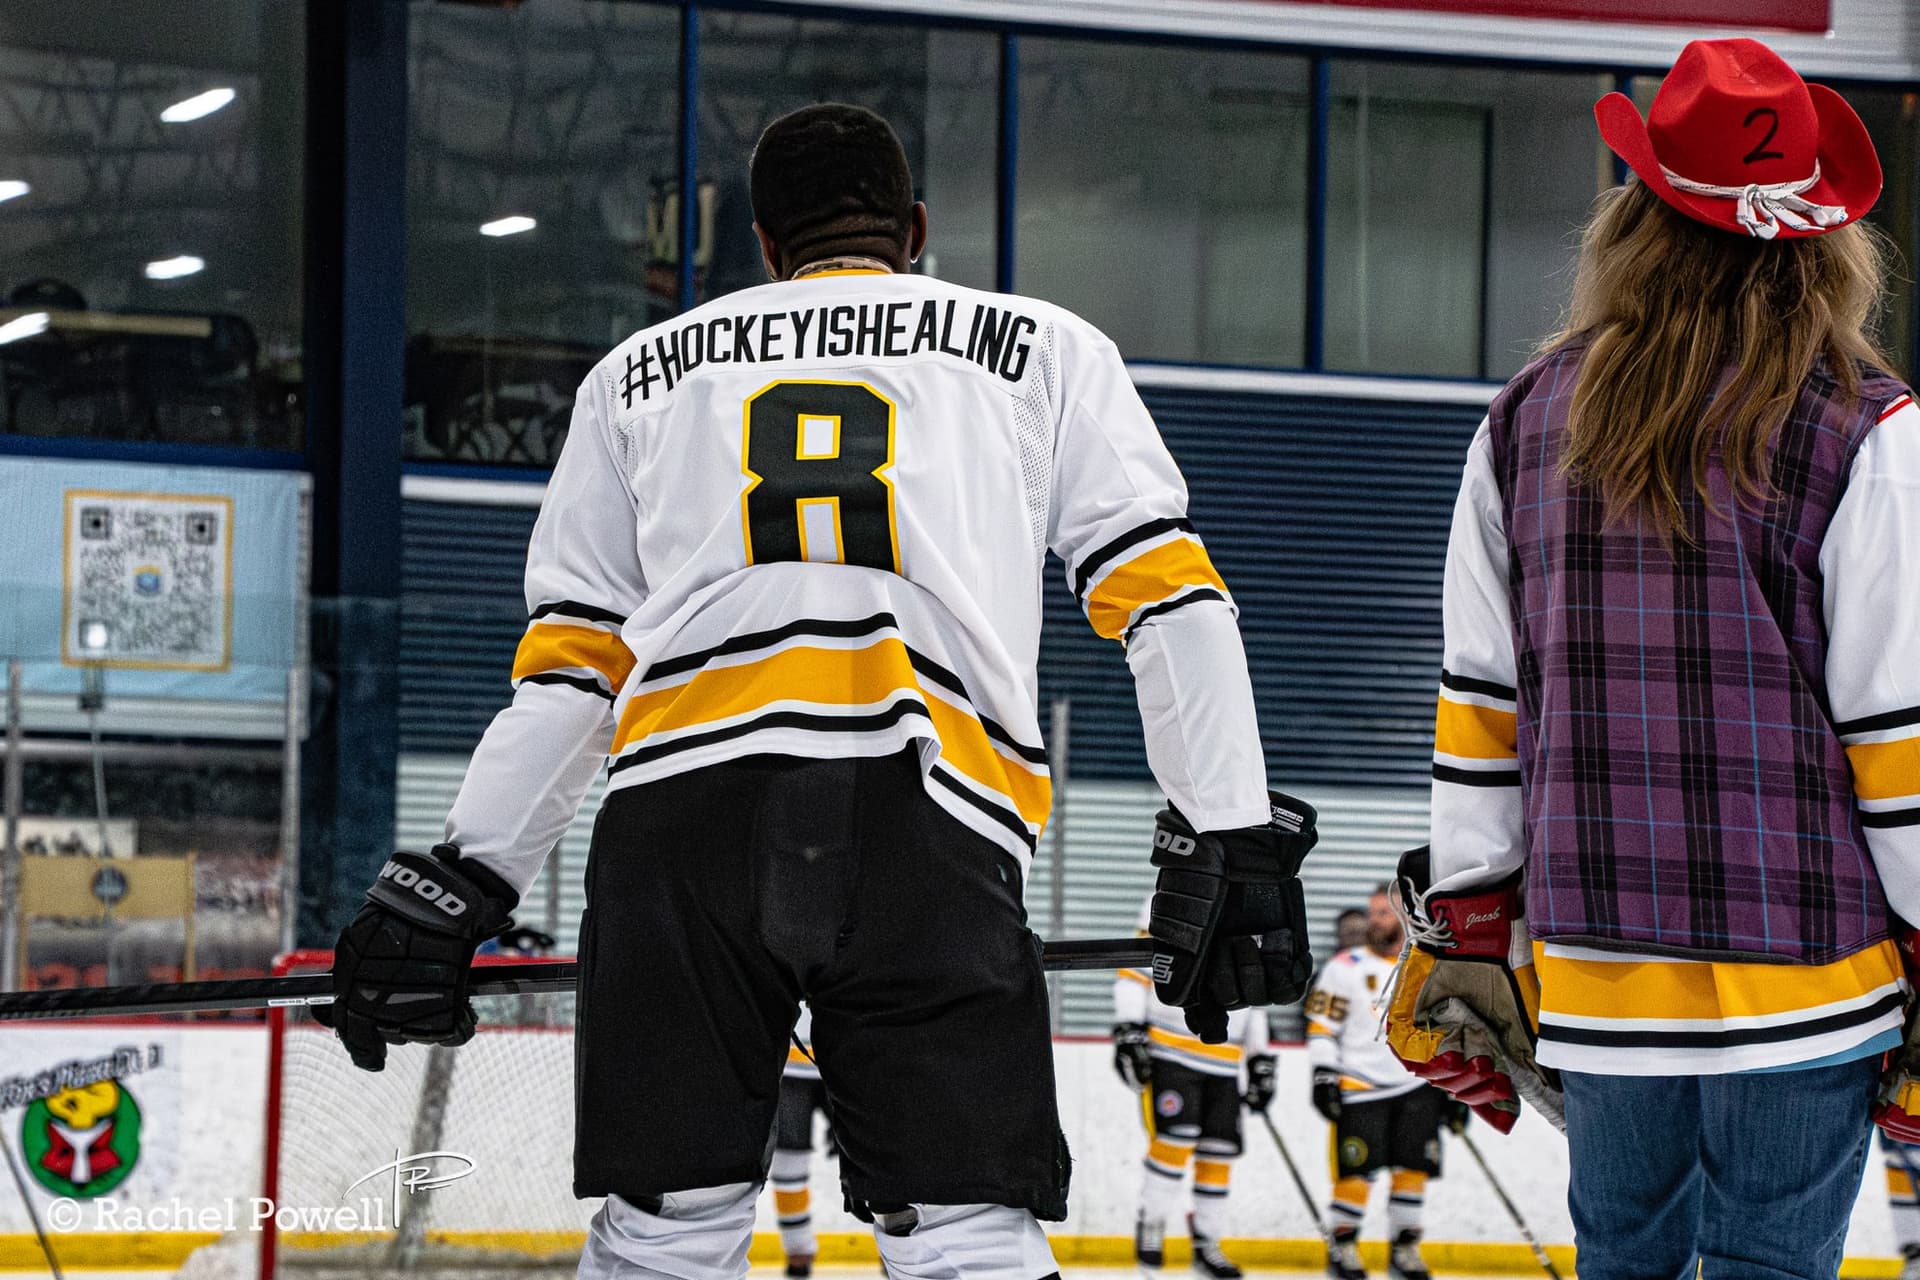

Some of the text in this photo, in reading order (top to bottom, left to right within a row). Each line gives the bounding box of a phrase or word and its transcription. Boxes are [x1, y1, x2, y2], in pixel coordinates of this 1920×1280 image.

[1743, 107, 1784, 164] 2
[619, 299, 1037, 410] #HOCKEYISHEALING
[741, 378, 902, 576] 8
[1465, 906, 1501, 930] Jacob
